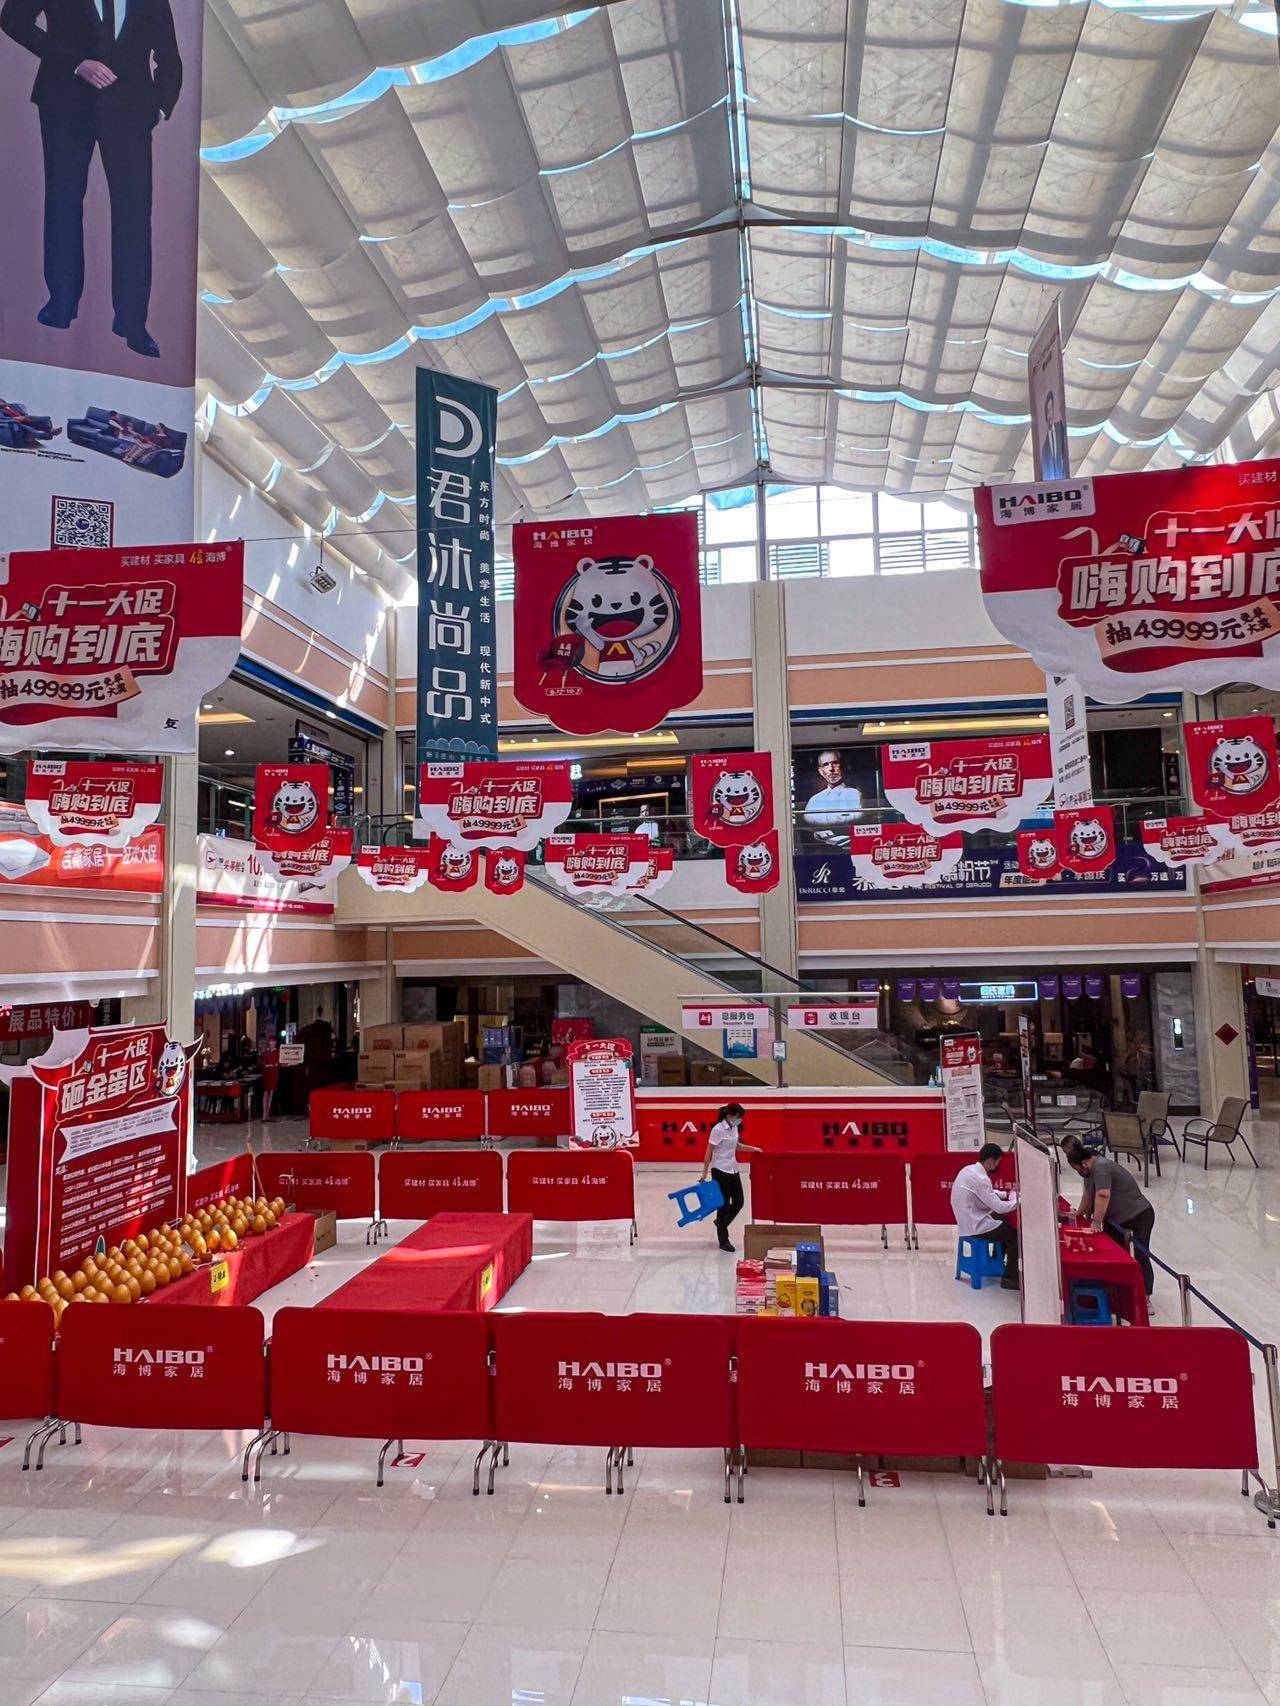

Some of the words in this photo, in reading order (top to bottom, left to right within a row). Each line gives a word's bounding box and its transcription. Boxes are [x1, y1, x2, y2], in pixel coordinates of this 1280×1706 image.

[999, 489, 1082, 509] HAIBO
[479, 481, 490, 542] 东方时尚
[532, 528, 594, 541] HAIBO
[120, 555, 151, 567] 买建材
[154, 553, 185, 565] 买家具
[479, 562, 491, 624] 美学生活
[48, 588, 164, 617] 十一大促
[1106, 618, 1246, 646] 抽49999元
[479, 645, 491, 724] 现代新中式
[954, 757, 1014, 772] 十一大促
[82, 779, 130, 793] 十一大促
[483, 780, 537, 793] 十一大促
[919, 774, 1016, 798] 嗨购到底
[51, 792, 130, 813] 嗨购到底
[451, 796, 538, 814] 嗨购到底
[588, 847, 626, 856] 十一大促
[874, 844, 938, 861] 嗨购到底
[566, 856, 626, 871] 嗨购到底
[97, 1037, 148, 1067] 十一大促
[61, 1060, 148, 1114] 砸金蛋区
[333, 1107, 373, 1115] HAIBO
[422, 1106, 463, 1114] HAIBO
[822, 1121, 908, 1136] HAIBO
[113, 1347, 205, 1364] HAIBO
[327, 1353, 424, 1372] HAIBO
[113, 1363, 204, 1379] 海博家居
[327, 1369, 423, 1386] 海博家居
[557, 1360, 663, 1378] HAIBO
[804, 1361, 915, 1379] HAIBO
[558, 1376, 662, 1393] 海博家居
[805, 1378, 915, 1395] 海博家居
[1060, 1375, 1178, 1394] HAIBO
[1062, 1393, 1179, 1409] 海博家居
